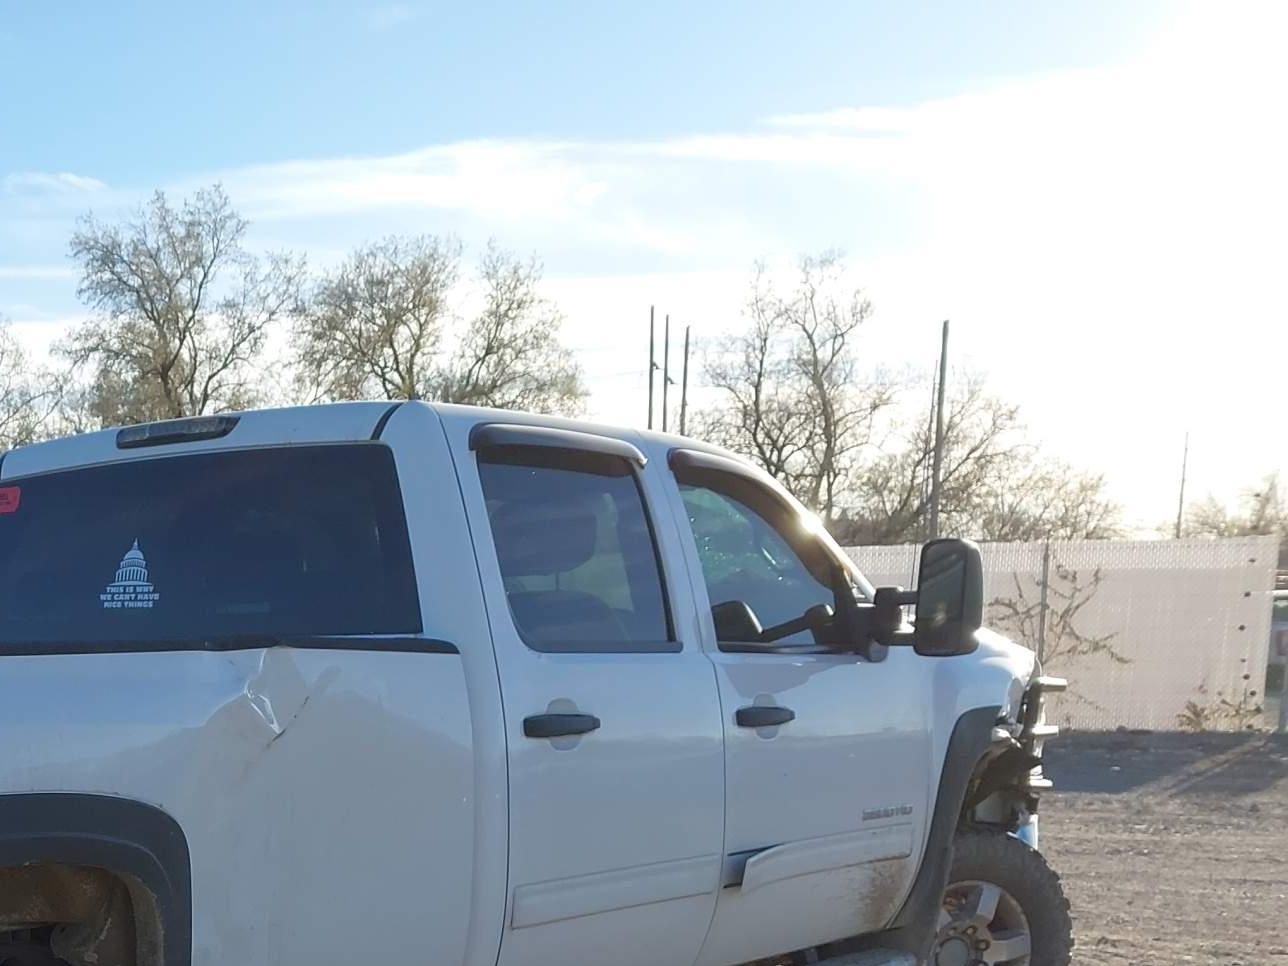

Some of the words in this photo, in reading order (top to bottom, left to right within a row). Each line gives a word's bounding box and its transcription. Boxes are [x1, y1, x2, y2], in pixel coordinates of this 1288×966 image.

[136, 585, 154, 593] WHY
[99, 593, 112, 601] WE
[137, 592, 160, 600] HAVE
